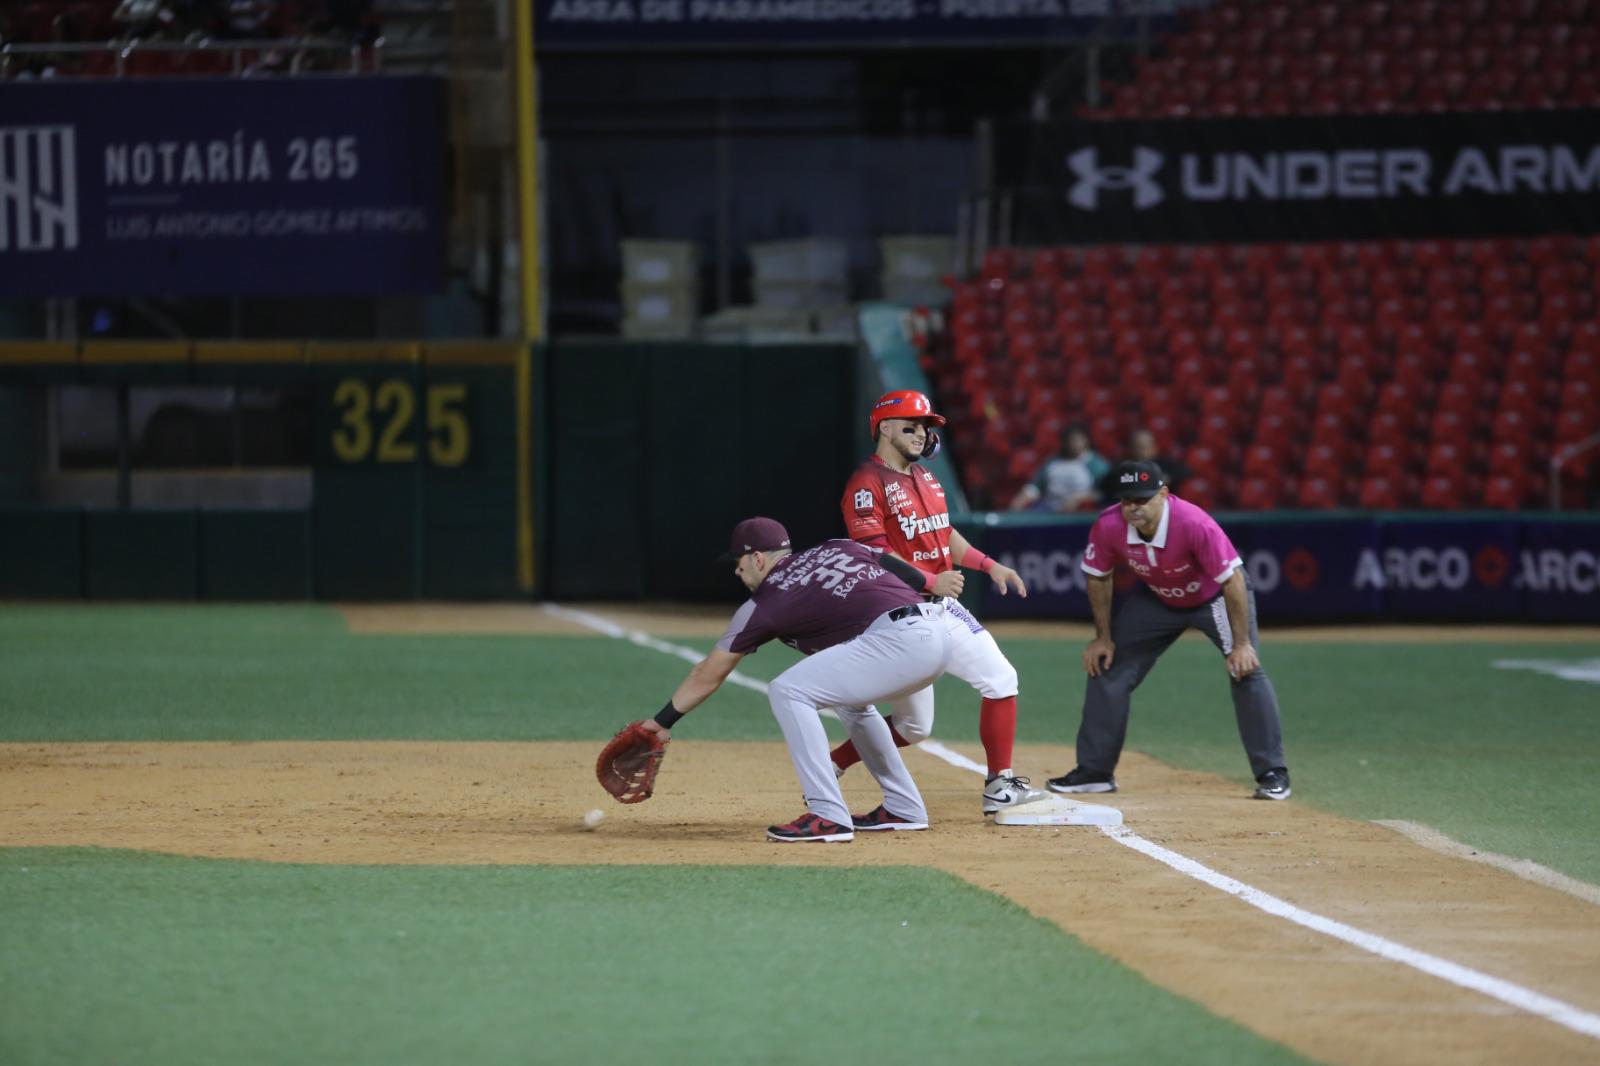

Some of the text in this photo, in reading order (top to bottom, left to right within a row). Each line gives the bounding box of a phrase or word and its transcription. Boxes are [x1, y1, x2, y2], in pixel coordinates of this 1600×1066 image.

[641, 0, 682, 21] DE
[105, 130, 359, 185] NOTARÍA 265
[1181, 144, 1600, 200] UNDER ARM
[106, 214, 150, 240] LUIS
[154, 210, 250, 238] ANTONIO
[331, 378, 469, 466] 325
[800, 552, 866, 590] 32
[1354, 546, 1470, 590] ARCO
[1513, 548, 1600, 594] ARC
[1149, 584, 1184, 598] CO
